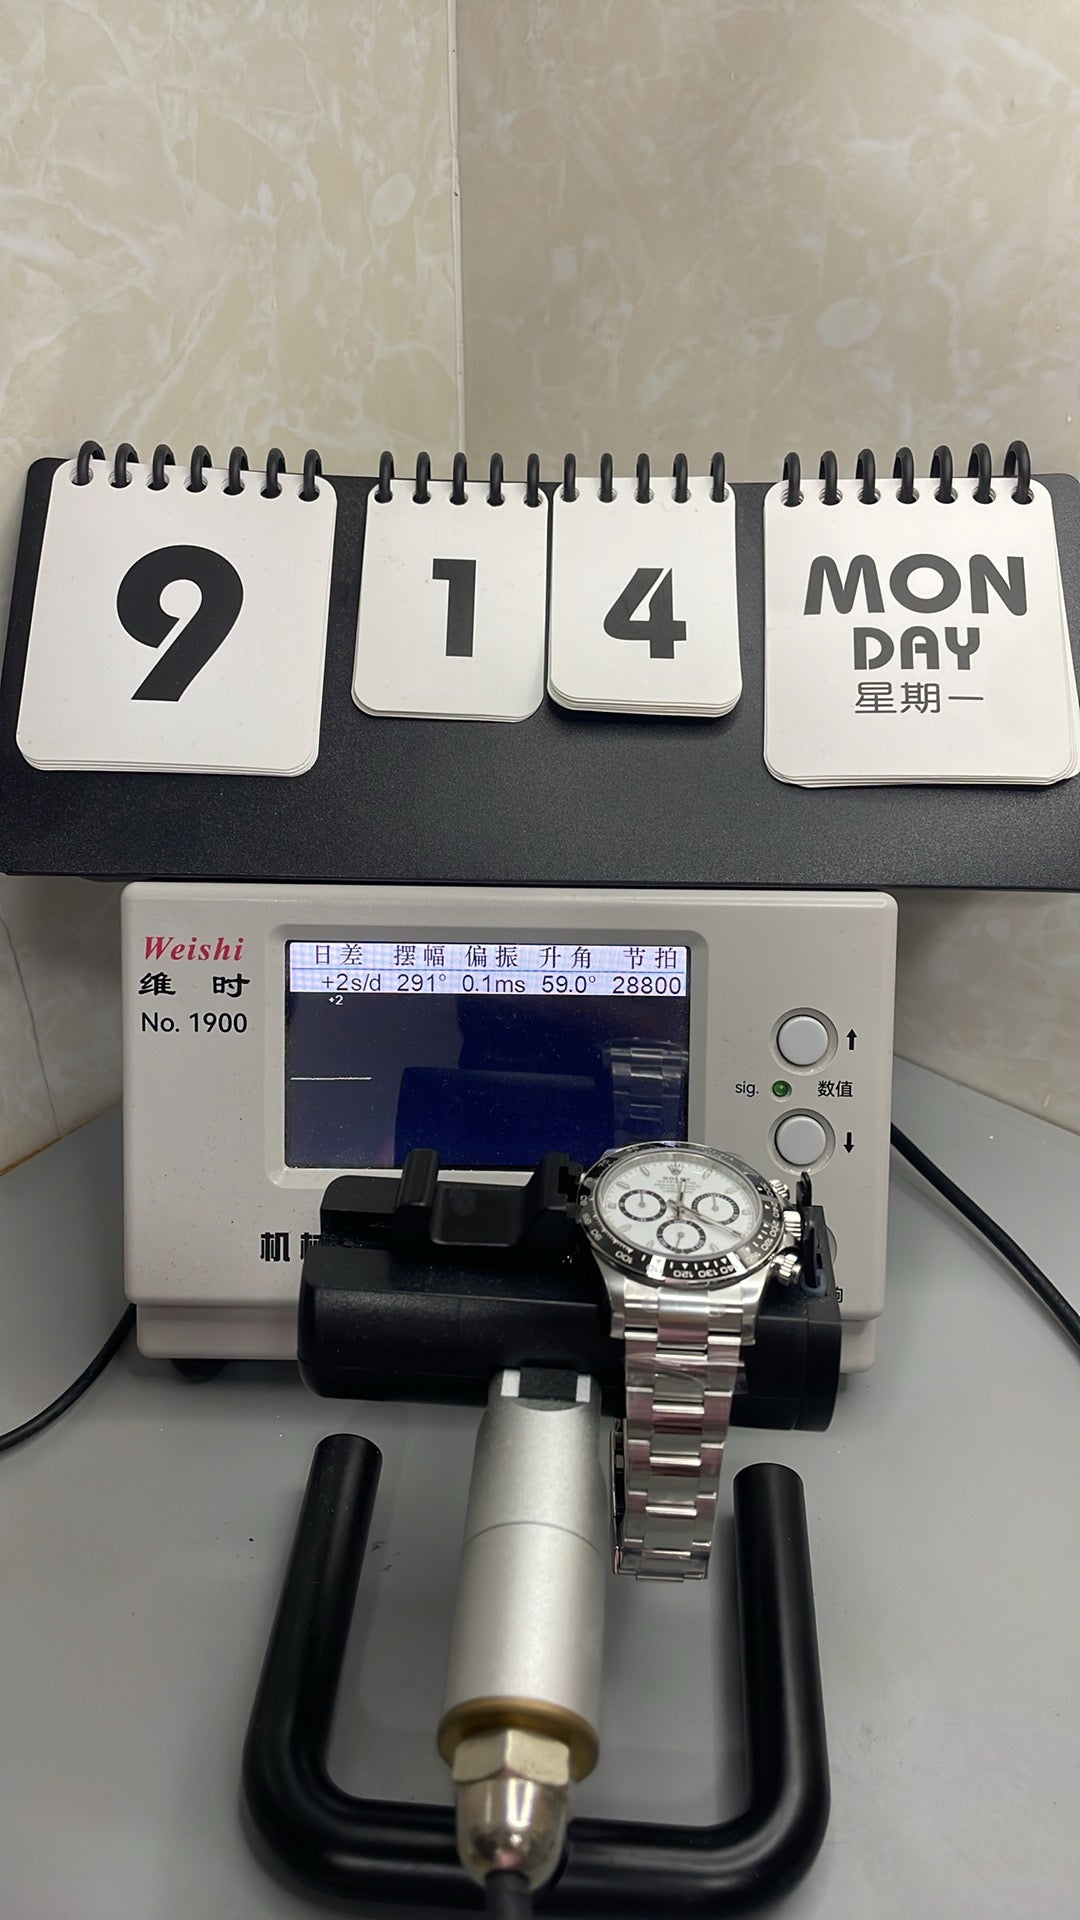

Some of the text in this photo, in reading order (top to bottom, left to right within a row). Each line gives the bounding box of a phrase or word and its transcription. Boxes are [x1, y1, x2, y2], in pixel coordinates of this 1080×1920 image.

[803, 553, 1028, 617] MON
[432, 557, 477, 658] 1
[602, 566, 688, 660] 4
[116, 544, 245, 702] 9
[853, 625, 982, 671] DAY
[854, 681, 985, 715] 星期一
[143, 936, 245, 961] Weishi
[314, 944, 678, 971] 日差 摆幅 偏振 升角 节拍
[321, 972, 682, 996] +2s/d 291° 0.1ms 59.0° 28800
[140, 1011, 248, 1034] No. 1900
[735, 1080, 760, 1099] sig.
[816, 1079, 854, 1099] 数值
